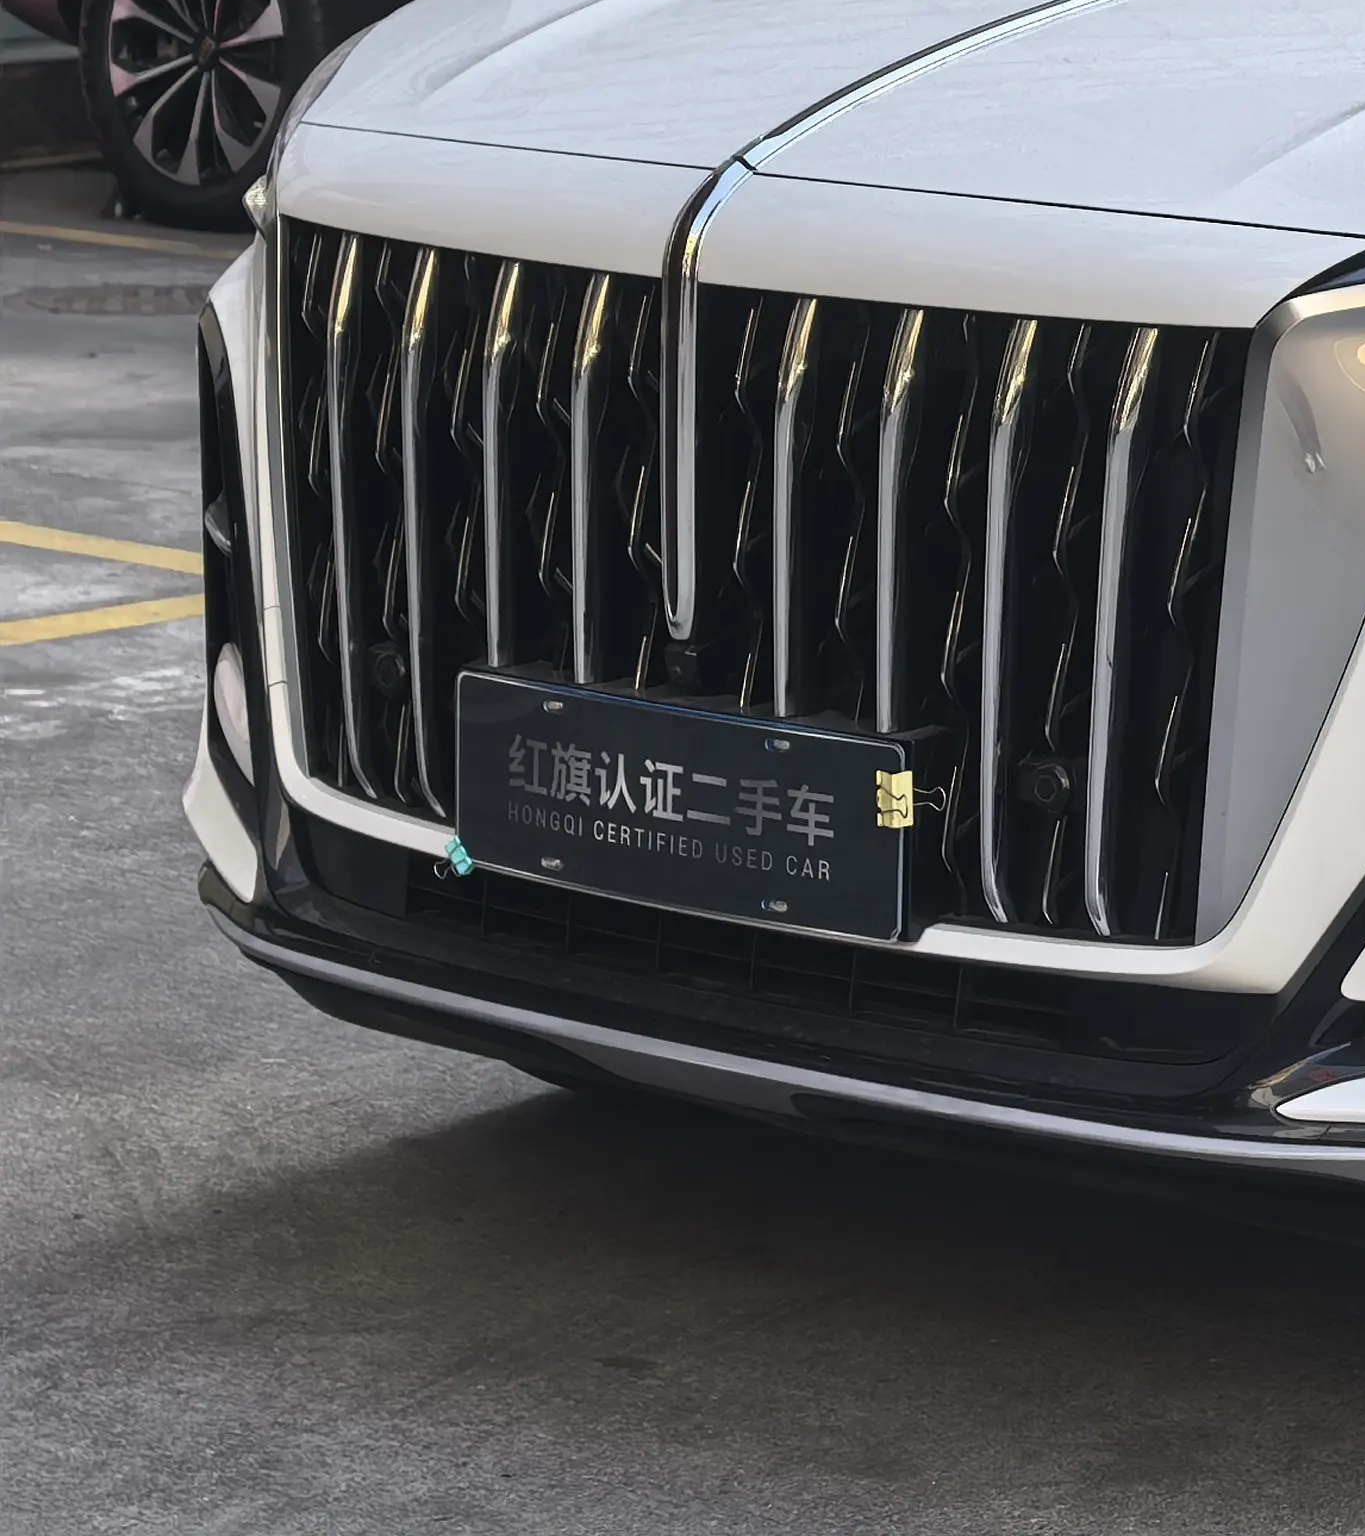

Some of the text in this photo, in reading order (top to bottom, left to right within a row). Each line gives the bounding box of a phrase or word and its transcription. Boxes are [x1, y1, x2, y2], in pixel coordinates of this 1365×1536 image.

[508, 733, 835, 847] 红旗认证二手车
[507, 801, 832, 882] HONGQI CERTIFIED USED CAR
